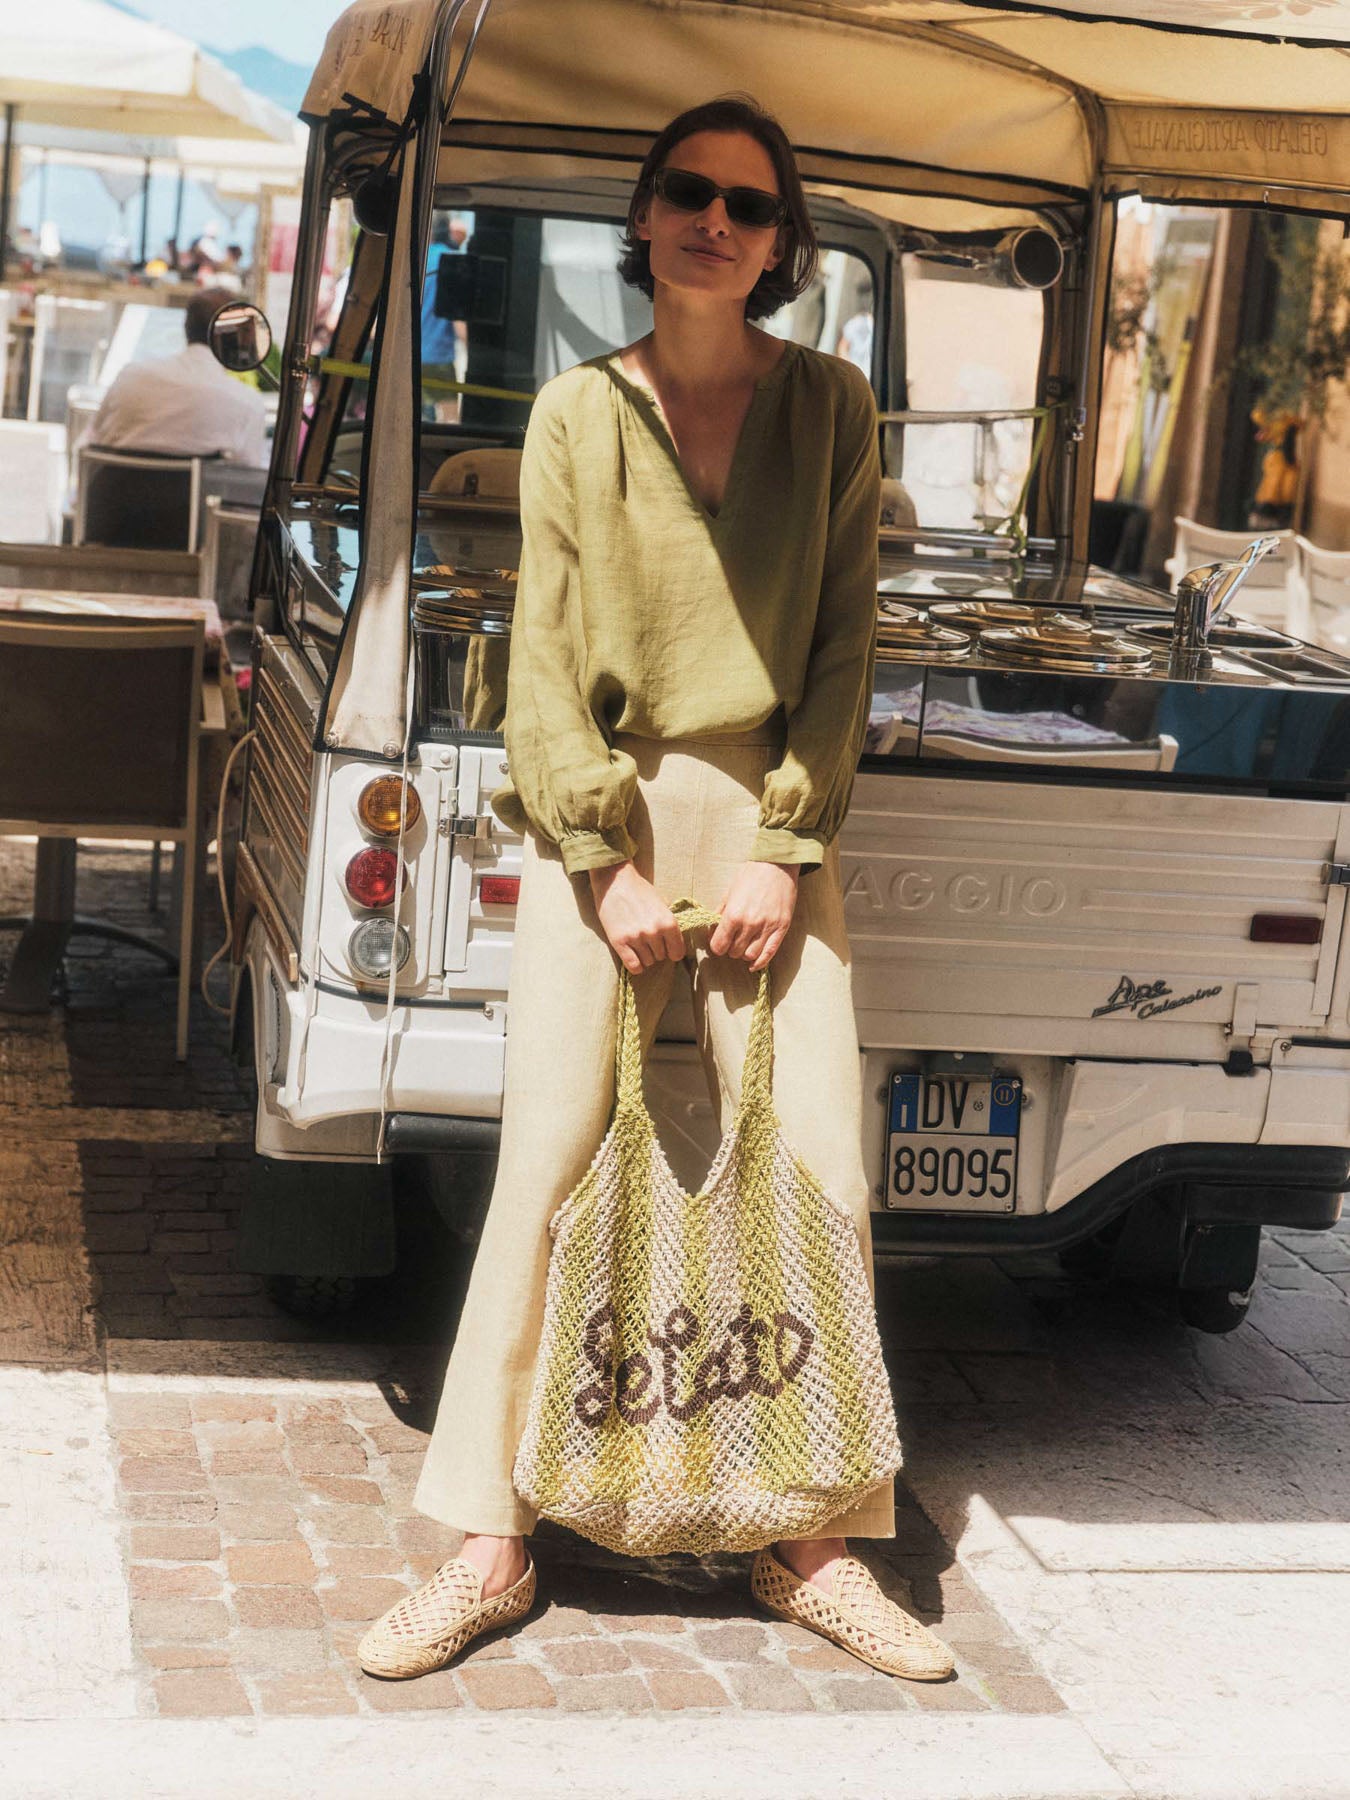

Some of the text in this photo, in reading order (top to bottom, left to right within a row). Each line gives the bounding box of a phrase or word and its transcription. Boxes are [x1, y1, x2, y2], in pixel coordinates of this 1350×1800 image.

[844, 866, 1067, 917] AGGIO
[1091, 975, 1173, 1018] Ape
[922, 1080, 969, 1130] DV
[894, 1146, 1012, 1198] 89095
